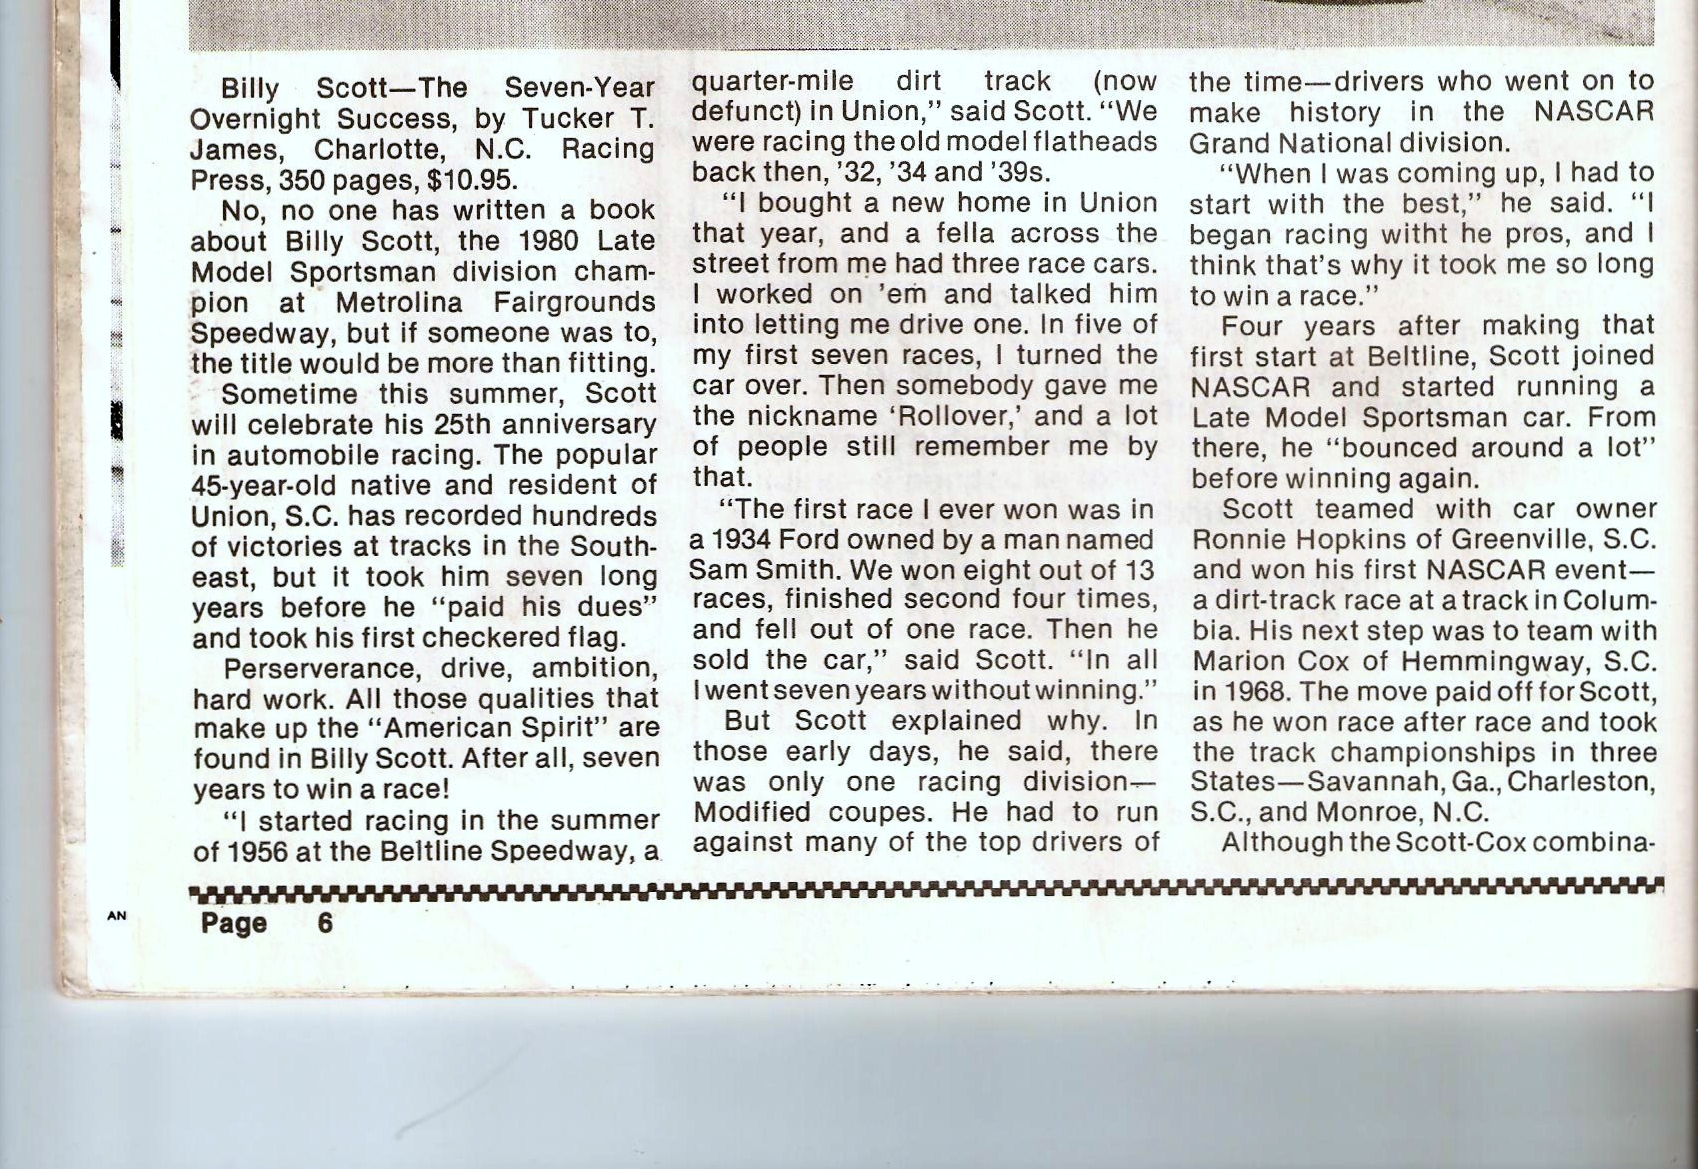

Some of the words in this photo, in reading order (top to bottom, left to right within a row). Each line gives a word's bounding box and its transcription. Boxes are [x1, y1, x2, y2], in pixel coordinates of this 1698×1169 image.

[223, 77, 279, 104] Billy
[506, 76, 655, 98] Seven-Year
[692, 100, 801, 126] defunct)
[811, 100, 832, 120] in
[951, 100, 1005, 121] said
[1015, 100, 1091, 121] Scott.
[1191, 102, 1260, 123] make
[1291, 101, 1380, 127] history
[1412, 100, 1433, 121] in
[1464, 100, 1504, 121] the
[1536, 100, 1653, 121] NASCAR
[192, 169, 271, 195] Press,
[280, 169, 324, 191] 350
[334, 174, 419, 195] pages,
[428, 168, 517, 192] $10.95.
[760, 191, 851, 217] bought
[865, 197, 879, 213] a
[893, 196, 944, 212] new
[959, 191, 1030, 212] home
[1045, 192, 1066, 212] in
[1081, 192, 1156, 212] Union
[1191, 224, 1270, 250] began
[1286, 223, 1367, 249] racing
[1382, 223, 1447, 244] witht
[1462, 222, 1491, 243] he
[1507, 227, 1570, 248] pros,
[1586, 222, 1632, 243] and
[1649, 222, 1652, 242] I
[192, 292, 247, 318] pion
[280, 292, 304, 313] at
[338, 291, 462, 313] Metrolina
[495, 291, 655, 317] Fairgrounds
[694, 313, 743, 334] into
[756, 313, 838, 339] letting
[851, 318, 889, 334] me
[900, 313, 963, 334] drive
[974, 318, 1028, 334] one.
[1042, 314, 1063, 334] In
[1075, 313, 1121, 334] five
[1134, 313, 1157, 333] of
[1191, 346, 1242, 367] first
[1256, 347, 1316, 367] start
[1330, 347, 1354, 367] at
[1369, 345, 1476, 370] Beltline,
[1490, 345, 1559, 366] Scott
[1573, 344, 1653, 371] joined
[223, 383, 357, 405] Sometime
[379, 383, 428, 404] this
[450, 387, 563, 408] summer,
[586, 382, 656, 403] Scott
[693, 404, 734, 426] the
[749, 405, 877, 426] nickname
[1035, 405, 1082, 426] and
[1097, 410, 1110, 426] a
[1126, 405, 1157, 425] lot
[1193, 437, 1266, 462] there,
[1283, 437, 1312, 457] he
[1472, 437, 1562, 458] around
[1579, 442, 1592, 457] a
[192, 505, 275, 531] Union,
[286, 505, 338, 526] S.C.
[349, 505, 395, 526] has
[406, 505, 521, 526] recorded
[534, 505, 657, 526] hundreds
[690, 533, 704, 550] a
[713, 528, 771, 549] 1934
[780, 529, 838, 549] Ford
[848, 529, 933, 550] owned
[944, 529, 972, 554] by
[981, 534, 995, 550] a
[1005, 534, 1059, 550] man
[1068, 529, 1152, 550] named
[1194, 528, 1285, 549] Ronnie
[1298, 528, 1405, 554] Hopkins
[1417, 528, 1442, 549] of
[1453, 528, 1592, 551] Greenville,
[1604, 528, 1655, 549] S.C.
[193, 601, 263, 623] years
[282, 596, 365, 618] before
[385, 596, 414, 617] he
[523, 595, 560, 616] his
[694, 618, 740, 639] and
[756, 618, 795, 639] fell
[811, 619, 853, 640] out
[868, 618, 892, 639] of
[907, 623, 954, 639] one
[970, 623, 1032, 639] race.
[1047, 618, 1111, 639] Then
[1129, 618, 1157, 638] he
[1194, 619, 1239, 640] bia.
[1251, 620, 1292, 640] His
[1303, 621, 1358, 640] next
[1368, 620, 1423, 645] step
[1433, 625, 1484, 641] was
[1493, 621, 1518, 640] to
[1528, 621, 1592, 641] team
[1602, 620, 1656, 641] with
[195, 718, 265, 739] make
[276, 722, 307, 743] up
[318, 717, 358, 738] the
[619, 721, 660, 737] are
[694, 740, 767, 761] those
[787, 740, 850, 766] early
[870, 740, 938, 766] days,
[960, 740, 988, 761] he
[1009, 740, 1070, 765] said,
[1091, 740, 1157, 760] there
[1193, 741, 1234, 762] the
[1250, 742, 1315, 762] track
[1332, 741, 1535, 767] championships
[1553, 742, 1573, 761] in
[1591, 741, 1657, 762] three
[194, 841, 219, 862] of
[228, 841, 288, 862] 1956
[297, 842, 321, 862] at
[330, 841, 370, 861] the
[382, 840, 482, 861] Beltline
[491, 840, 634, 865] Speedway,
[645, 845, 659, 860] a
[694, 831, 792, 856] against
[806, 836, 877, 856] many
[890, 831, 914, 851] of
[926, 831, 966, 851] the
[979, 832, 1020, 855] top
[1033, 831, 1122, 851] drivers
[1136, 831, 1160, 851] of
[1222, 831, 1342, 857] Although
[1350, 831, 1390, 852] the
[1397, 831, 1526, 852] Scott-Cox
[1534, 832, 1655, 852] combina-
[108, 911, 126, 920] AN
[202, 912, 267, 938] Page
[318, 912, 332, 933] 6
